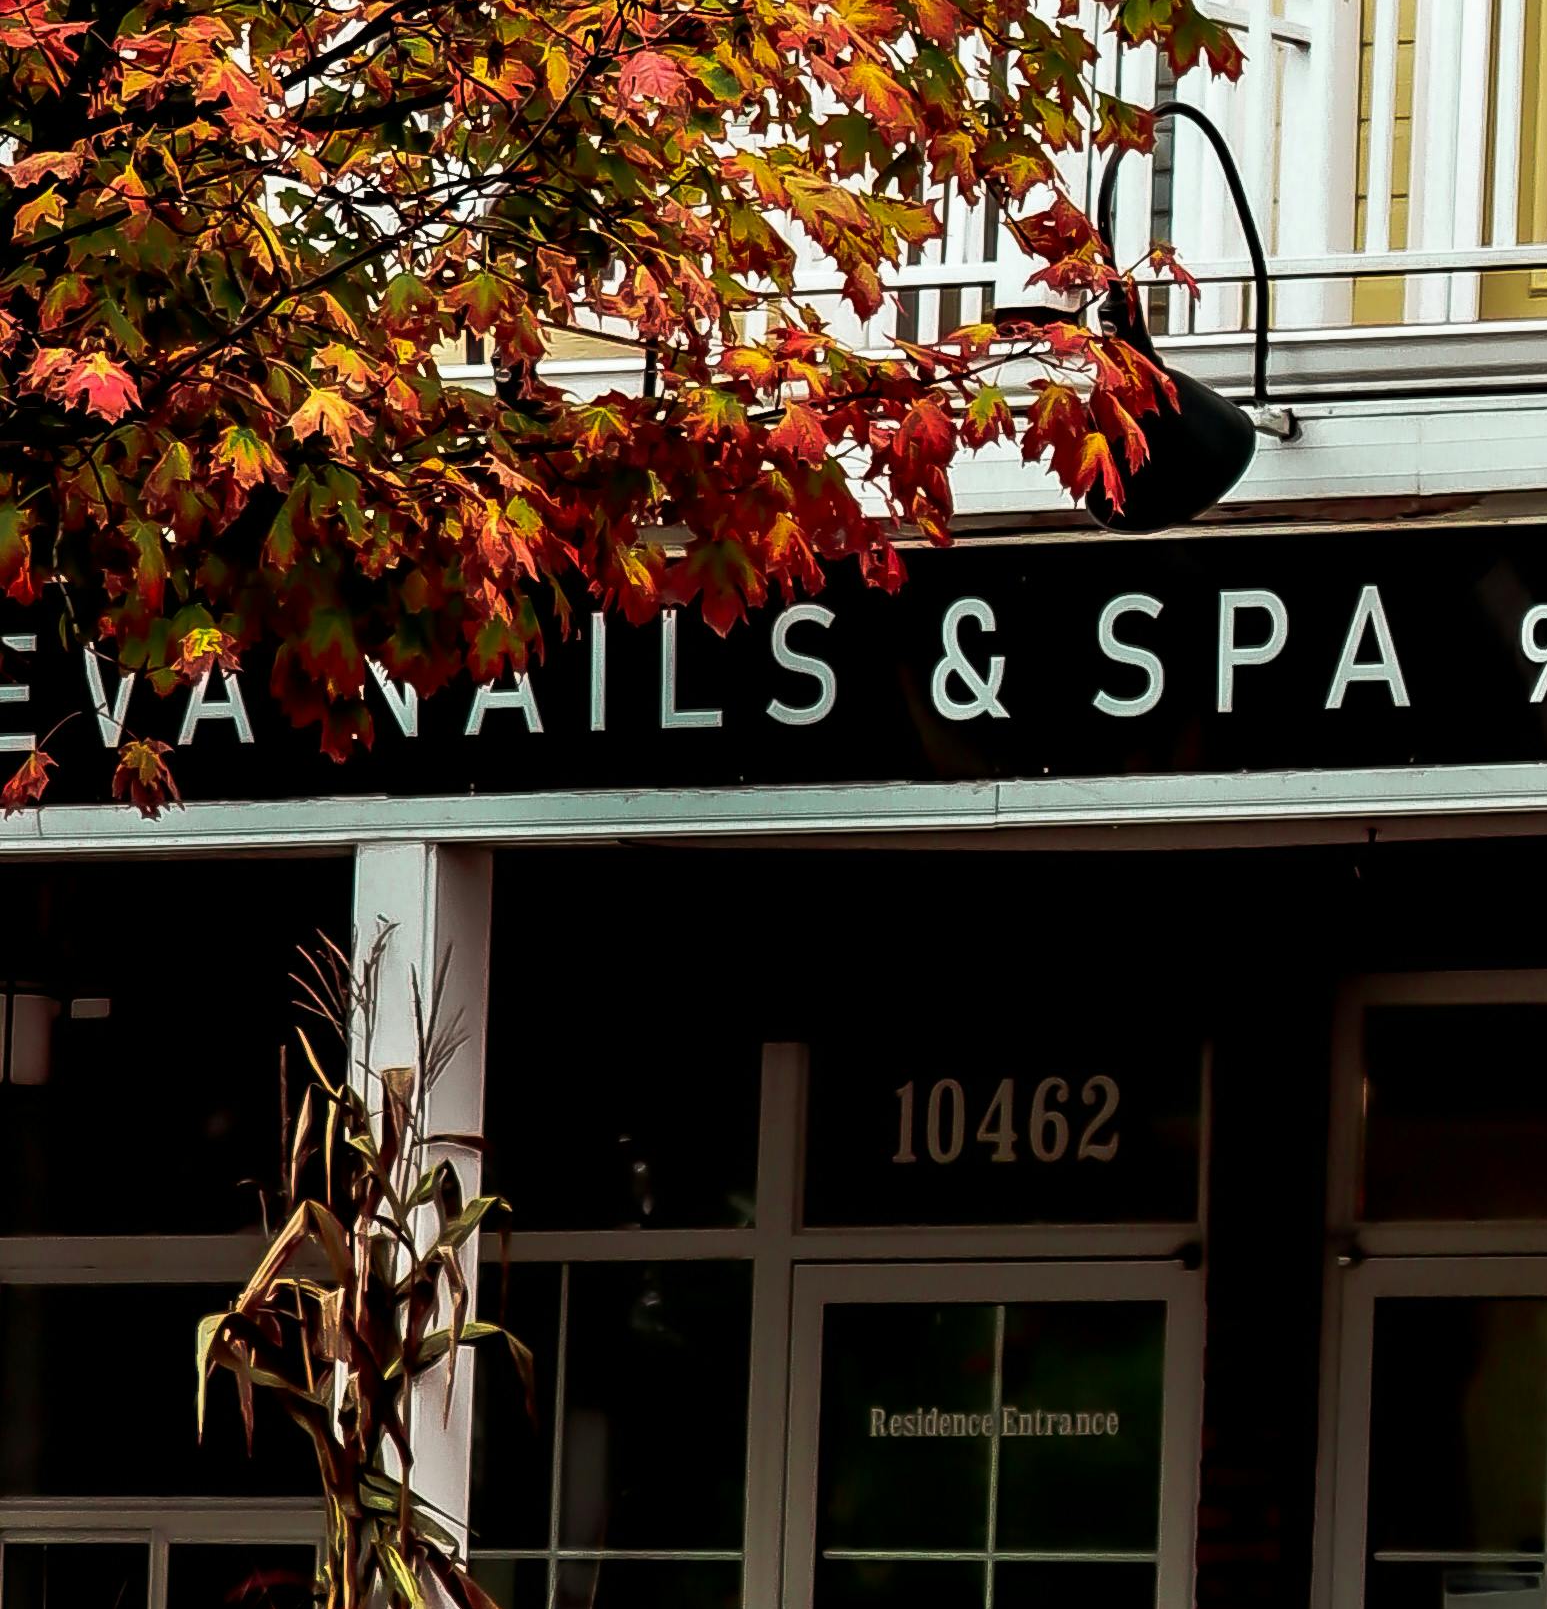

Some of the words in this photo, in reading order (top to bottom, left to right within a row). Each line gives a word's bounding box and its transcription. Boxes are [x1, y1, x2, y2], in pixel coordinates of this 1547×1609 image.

[931, 596, 1010, 721] &
[1093, 584, 1411, 718] SPA
[893, 1075, 1121, 1164] 10462
[868, 1406, 993, 1438] Residence
[999, 1404, 1120, 1436] Entrance
